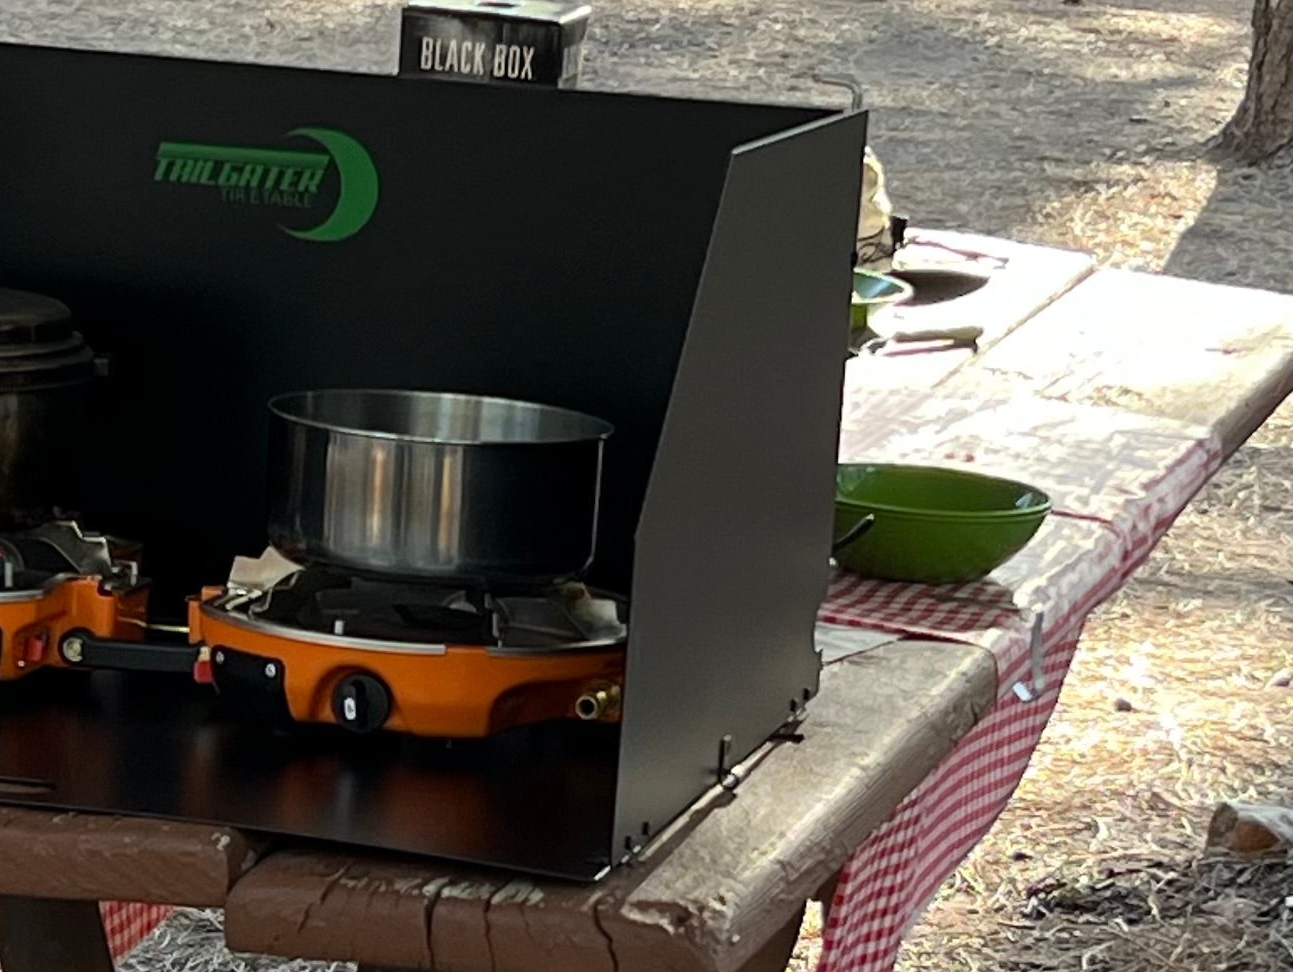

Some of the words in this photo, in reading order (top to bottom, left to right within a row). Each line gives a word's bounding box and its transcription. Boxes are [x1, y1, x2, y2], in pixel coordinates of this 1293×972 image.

[420, 36, 486, 76] BLACK
[492, 43, 536, 80] BOX
[154, 156, 325, 194] TAILGATER
